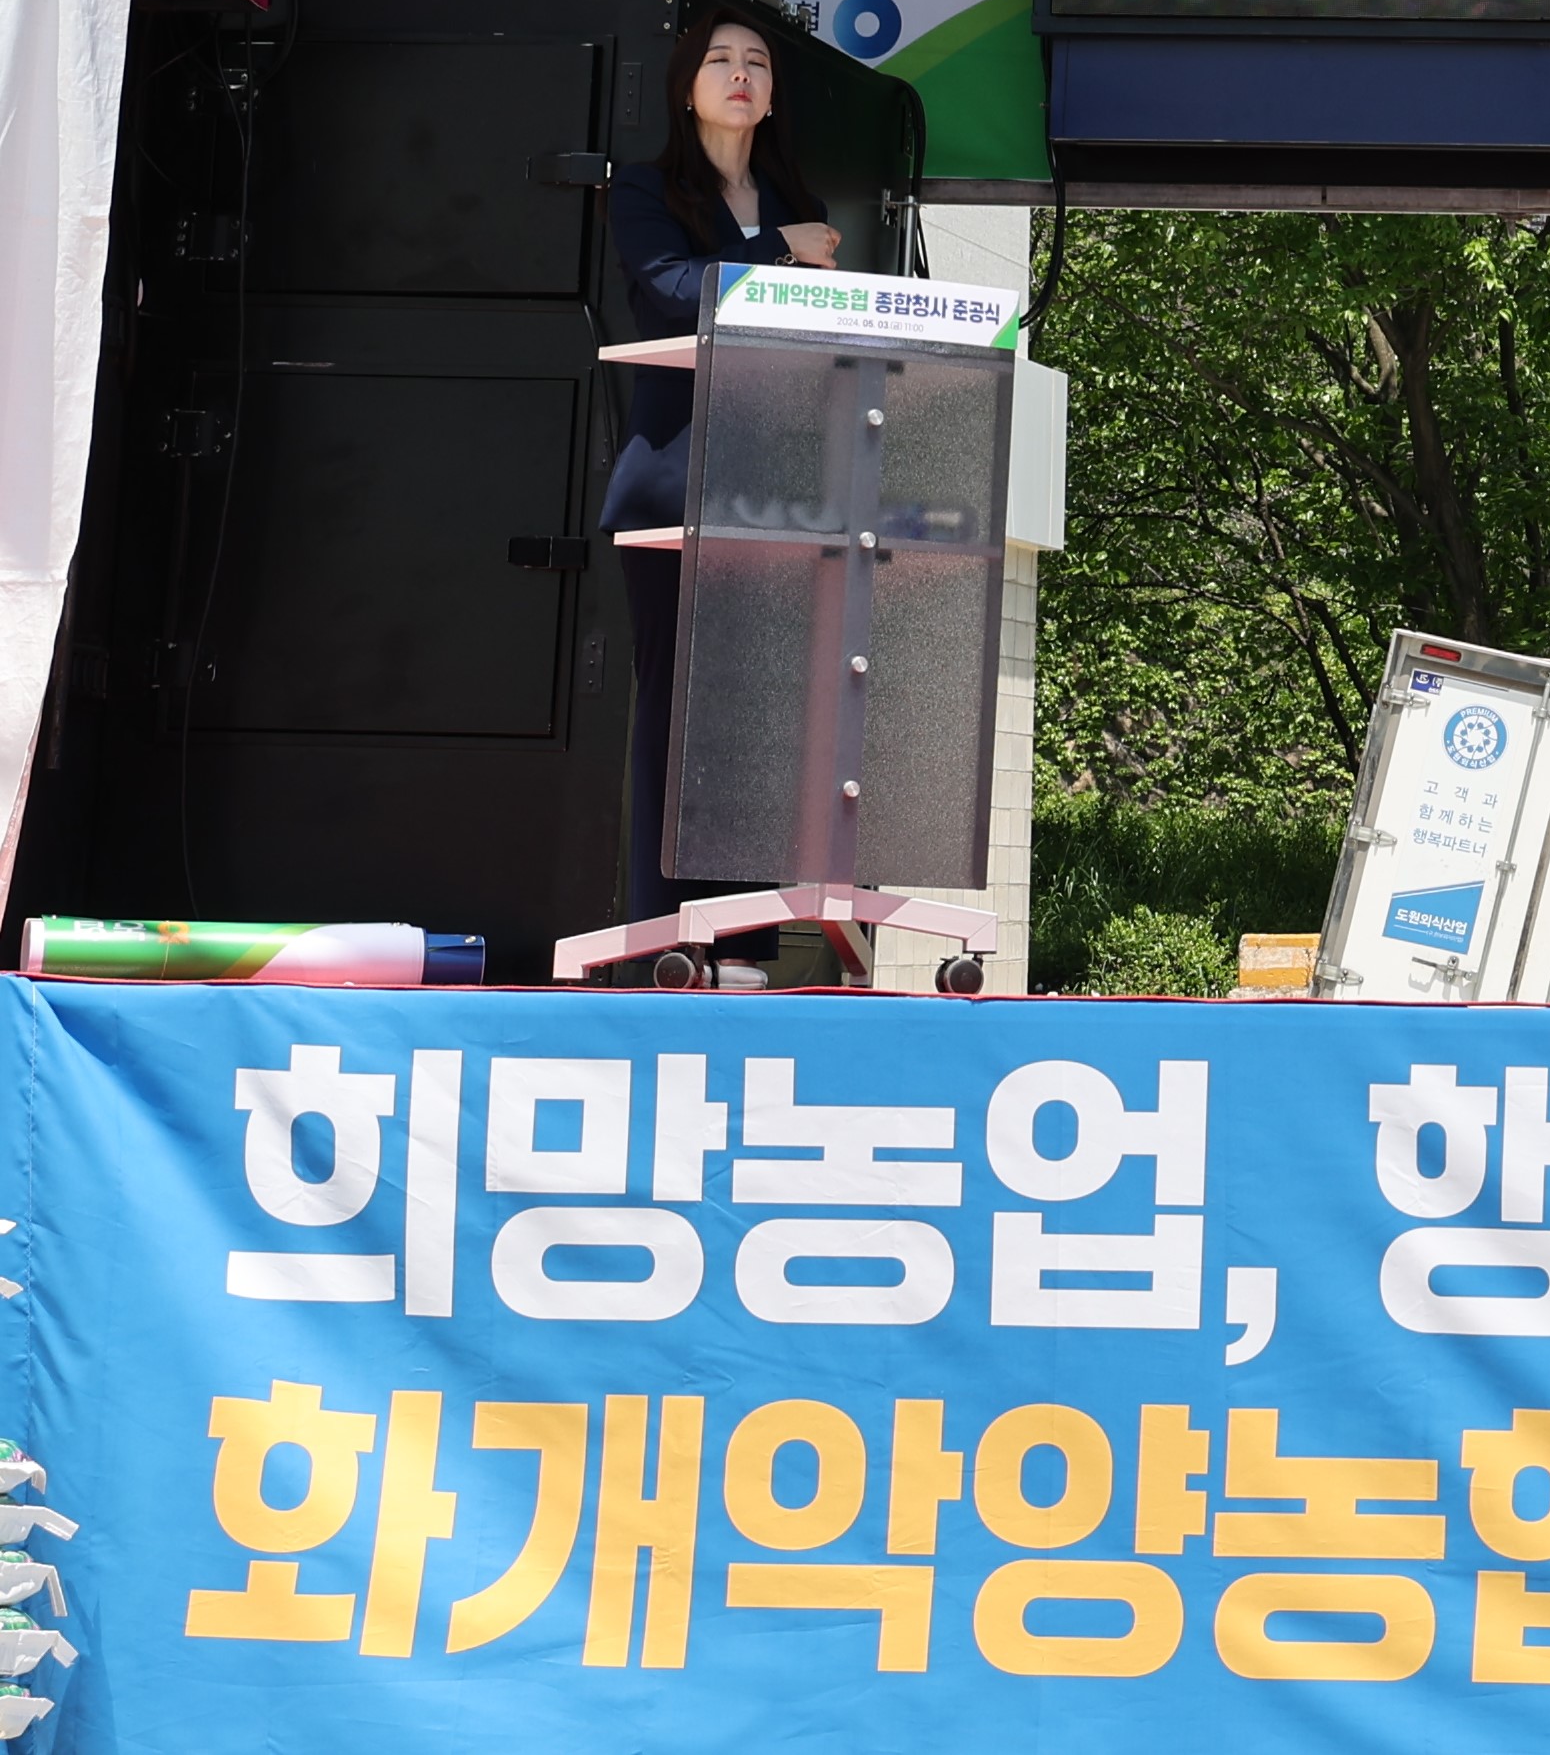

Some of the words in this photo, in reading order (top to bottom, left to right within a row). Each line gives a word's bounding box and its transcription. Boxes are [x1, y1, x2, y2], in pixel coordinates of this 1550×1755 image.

[744, 279, 869, 312] 화개악양농협
[874, 290, 948, 319] 종합청사
[952, 298, 1000, 325] 준공식
[1412, 828, 1488, 858] 행복파트너
[1394, 908, 1468, 935] 도원외식산업
[226, 1044, 1277, 1366] 희망농업,
